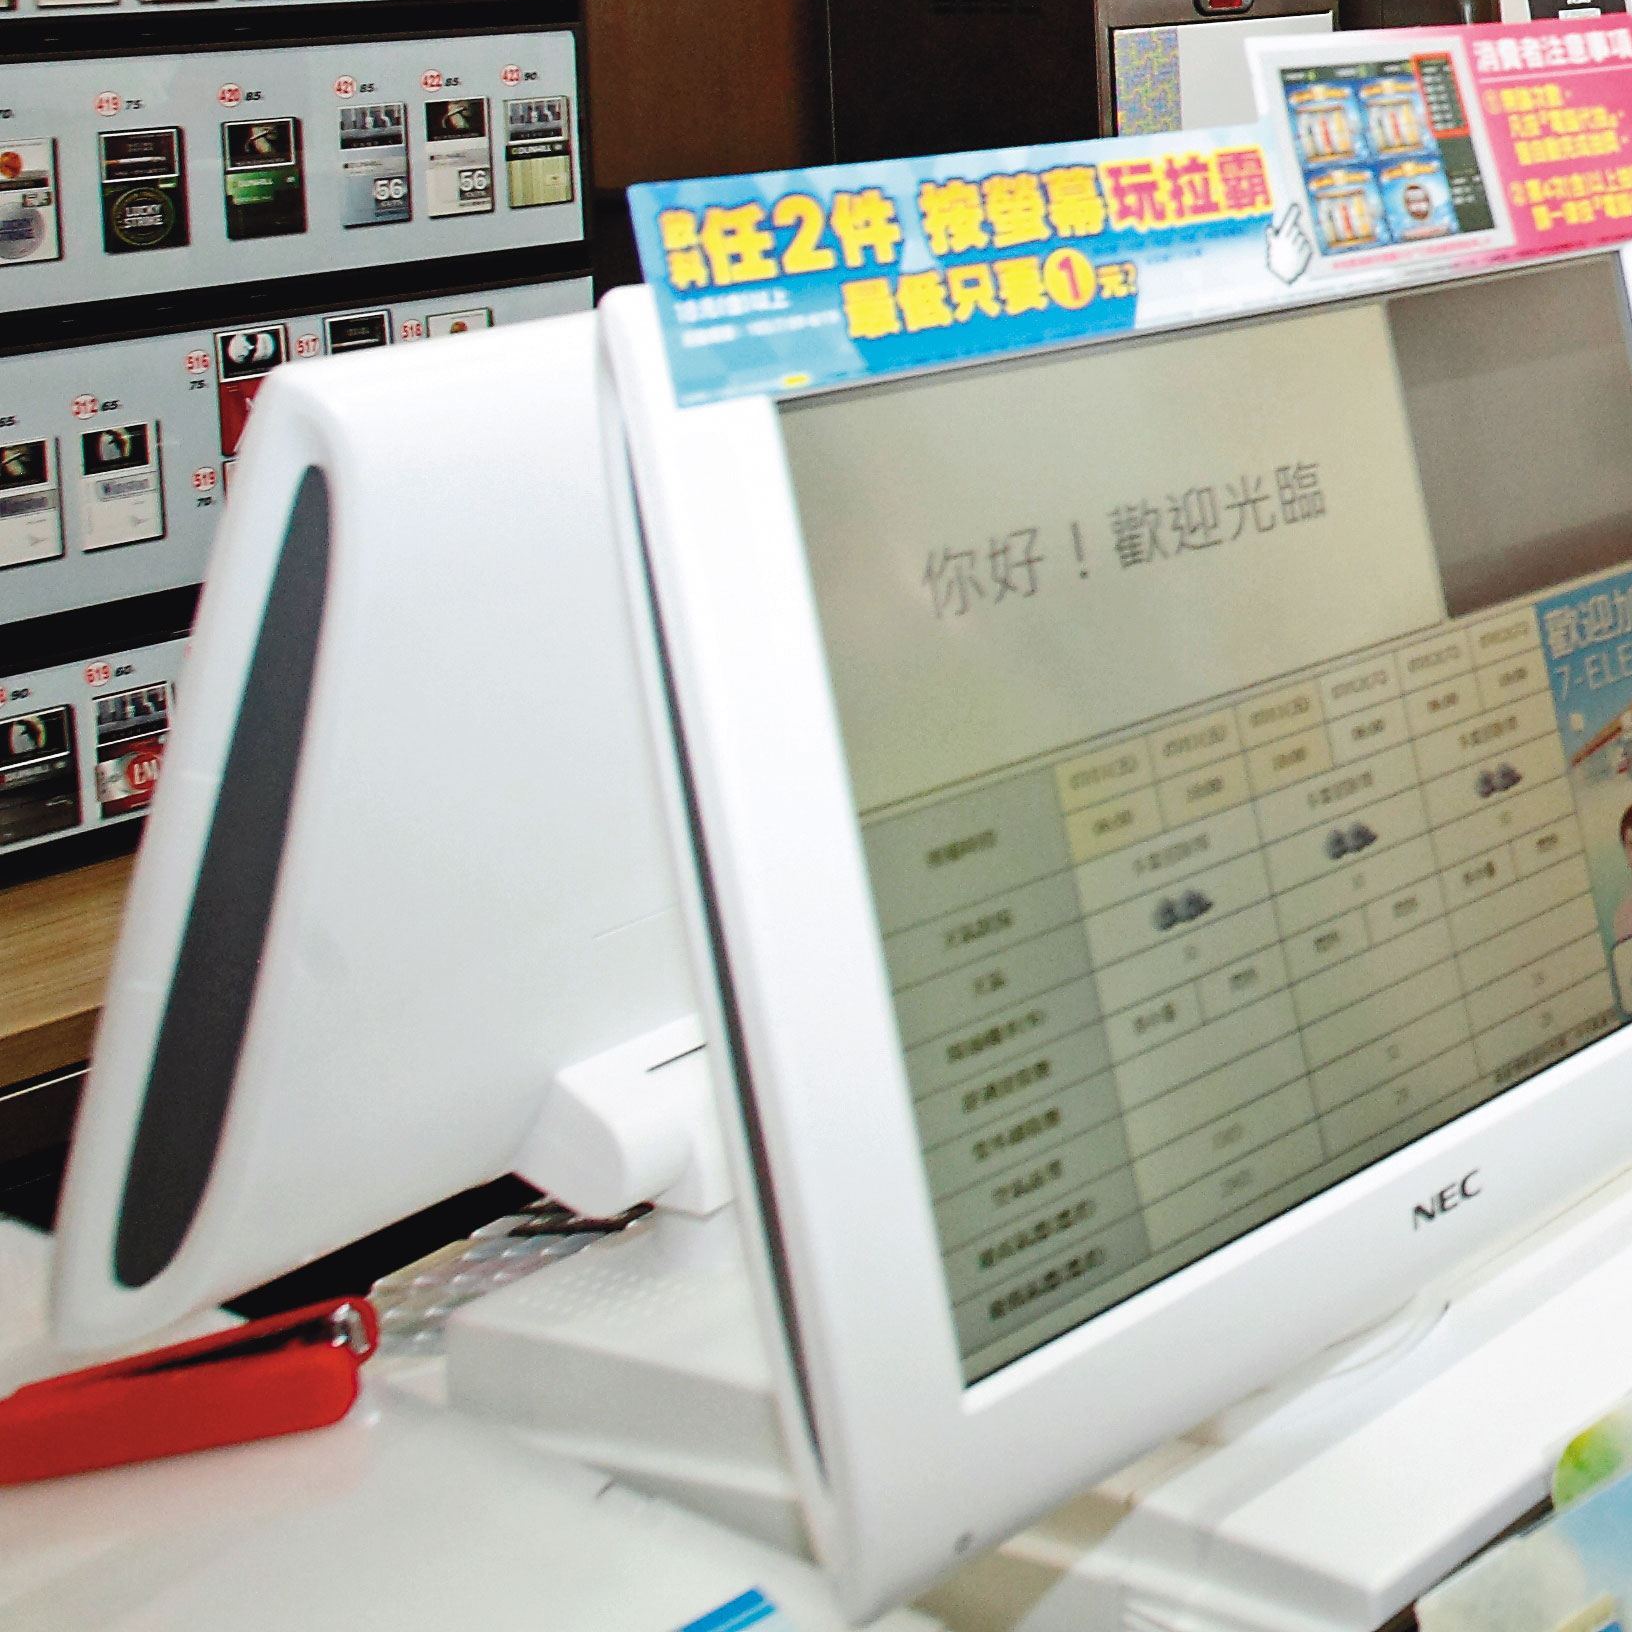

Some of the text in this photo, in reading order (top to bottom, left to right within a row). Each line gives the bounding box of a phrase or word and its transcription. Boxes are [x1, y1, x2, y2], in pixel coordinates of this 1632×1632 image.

[374, 178, 405, 201] 56
[459, 170, 489, 192] 56
[699, 187, 904, 288] 任2件
[918, 144, 1276, 257] 按螢幕玩拉霸
[296, 337, 320, 355] 517
[1412, 1167, 1482, 1231] NEC
